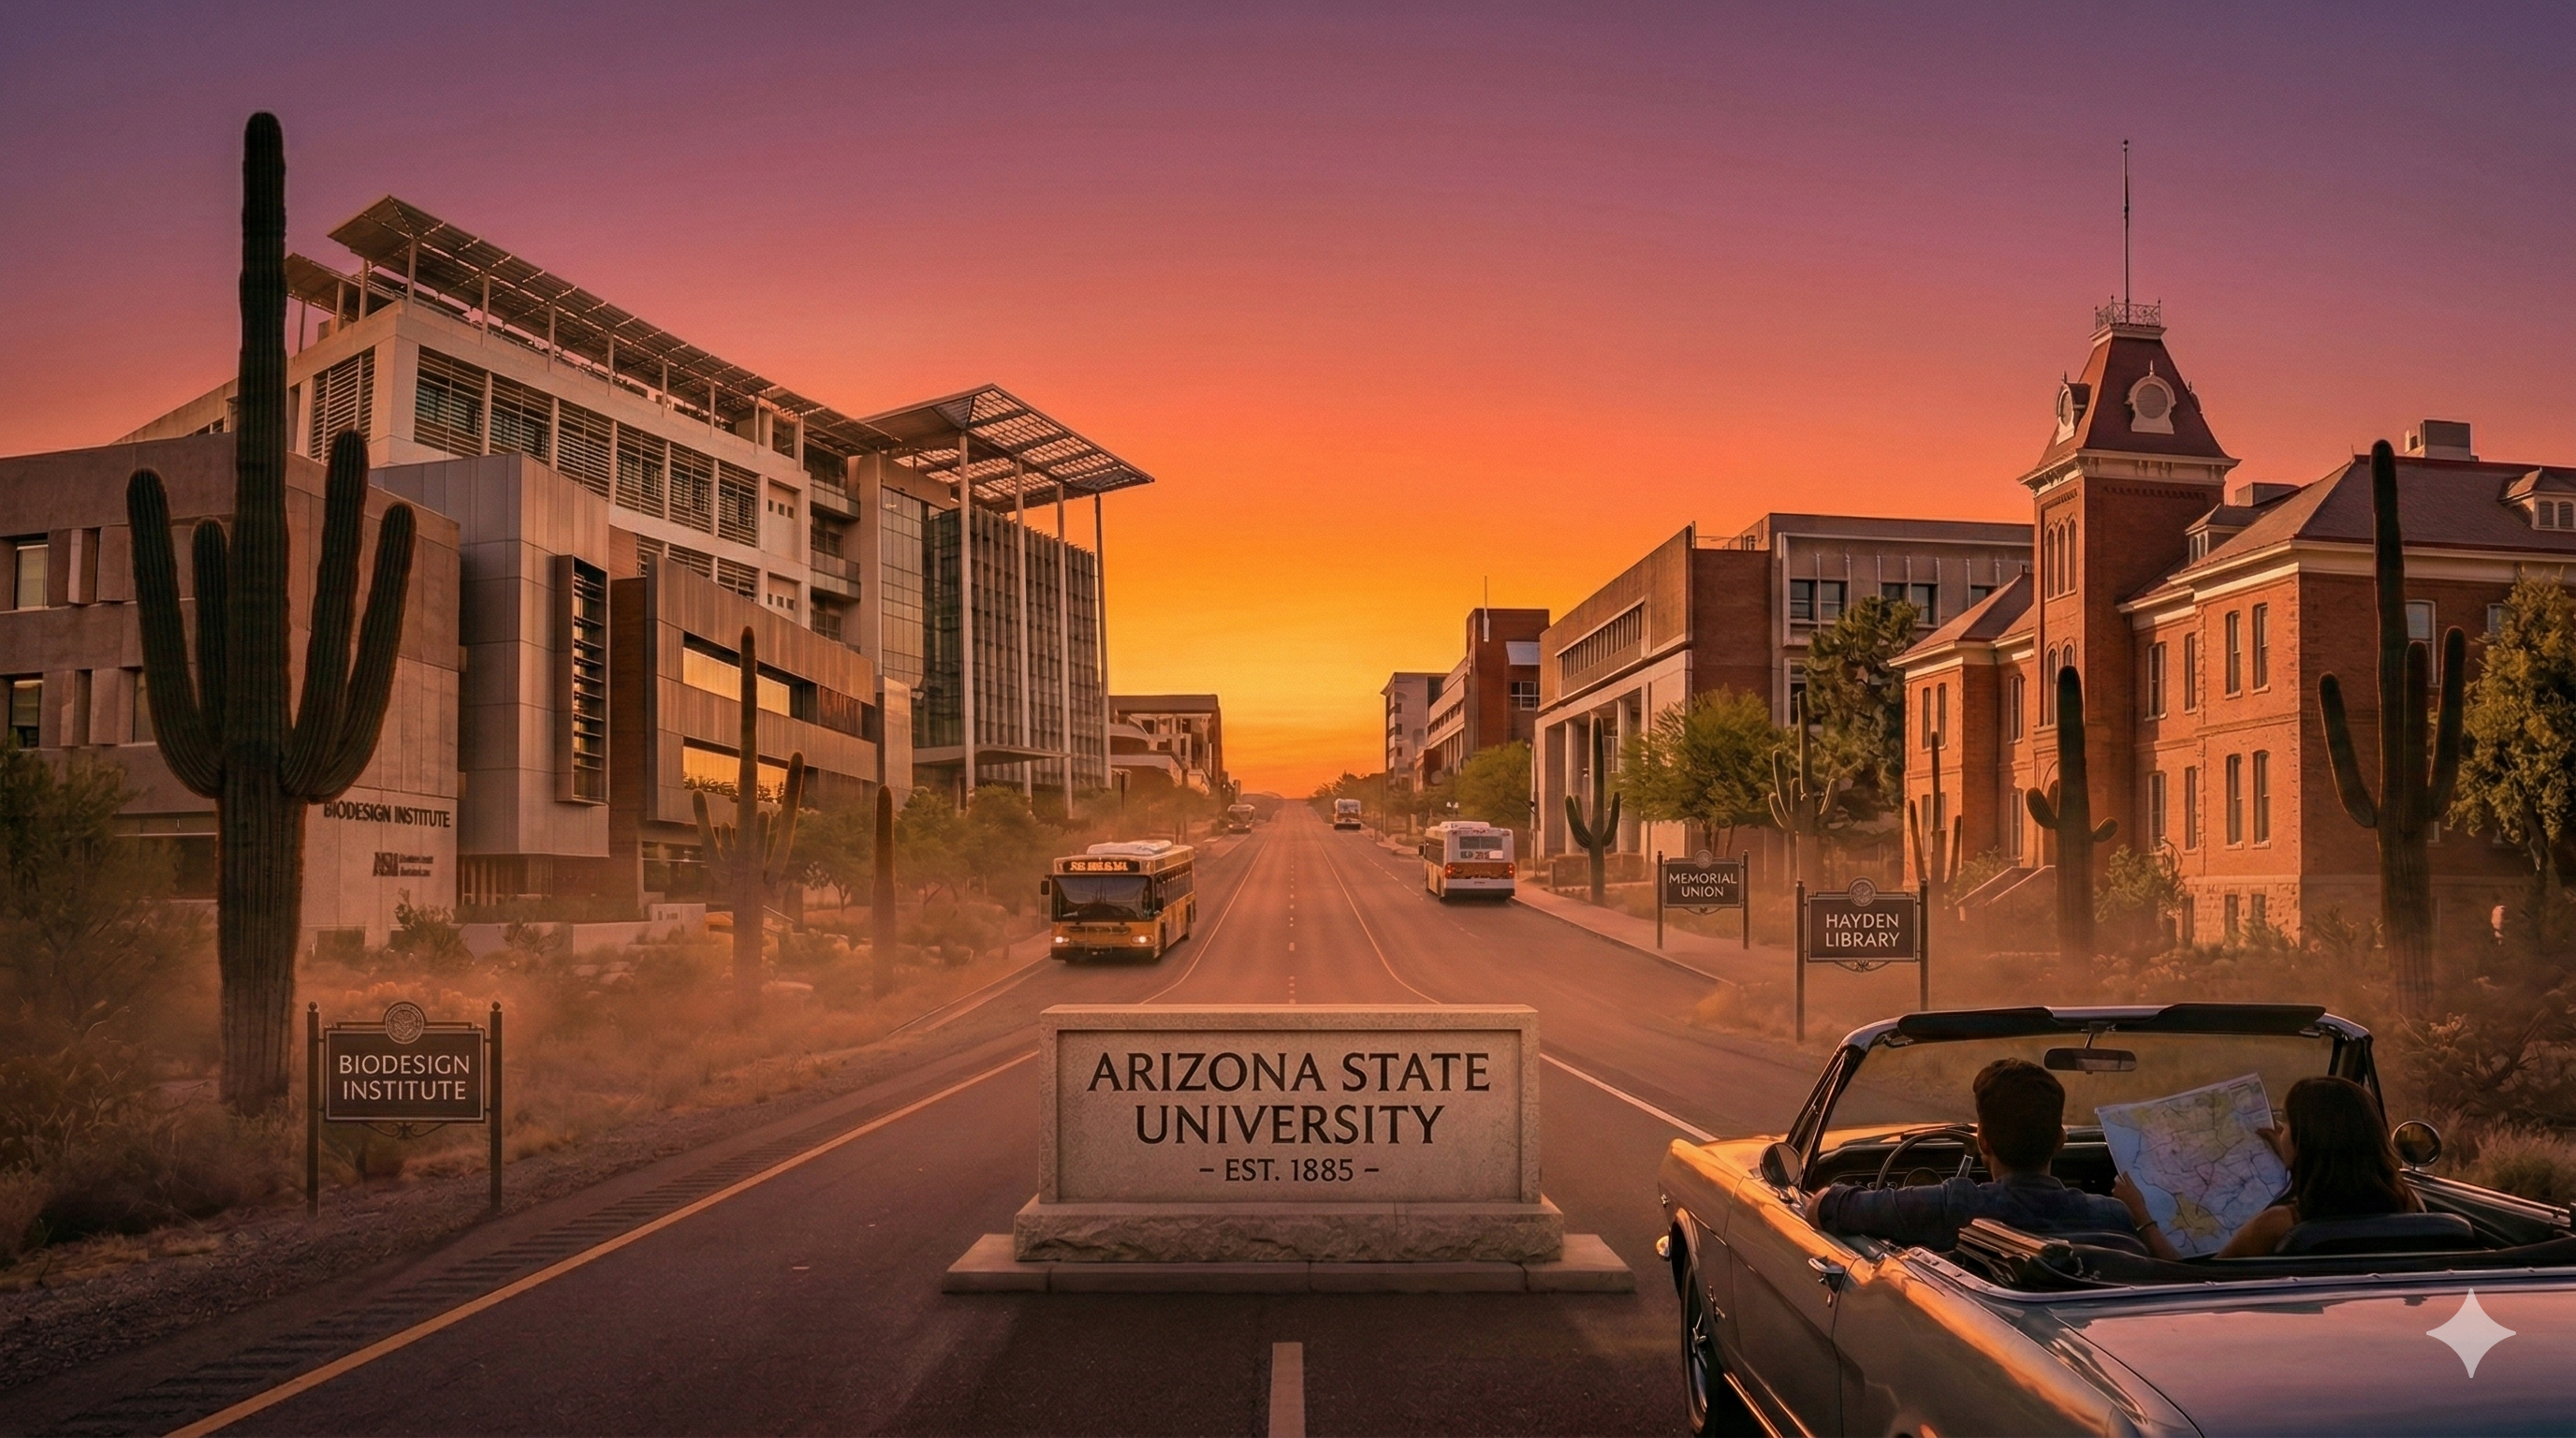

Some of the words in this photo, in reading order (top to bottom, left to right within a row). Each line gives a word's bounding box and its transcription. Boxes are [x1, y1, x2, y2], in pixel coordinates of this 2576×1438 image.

[324, 800, 391, 823] BIODESIGN
[394, 806, 450, 828] INSTITUTE
[1668, 873, 1737, 884] MEMORIAL
[1681, 886, 1724, 898] UNION
[1825, 914, 1899, 928] HAYDEN
[1825, 932, 1900, 947] LIBRARY
[339, 1055, 470, 1074] BIODESIGN
[1087, 1052, 1327, 1092] ARIZONA
[1341, 1052, 1491, 1092] STATE
[344, 1080, 466, 1100] INSTITUTE
[1135, 1105, 1445, 1144] UNIVERSITY
[1224, 1158, 1280, 1181] EST.
[1290, 1158, 1354, 1181] 1885
